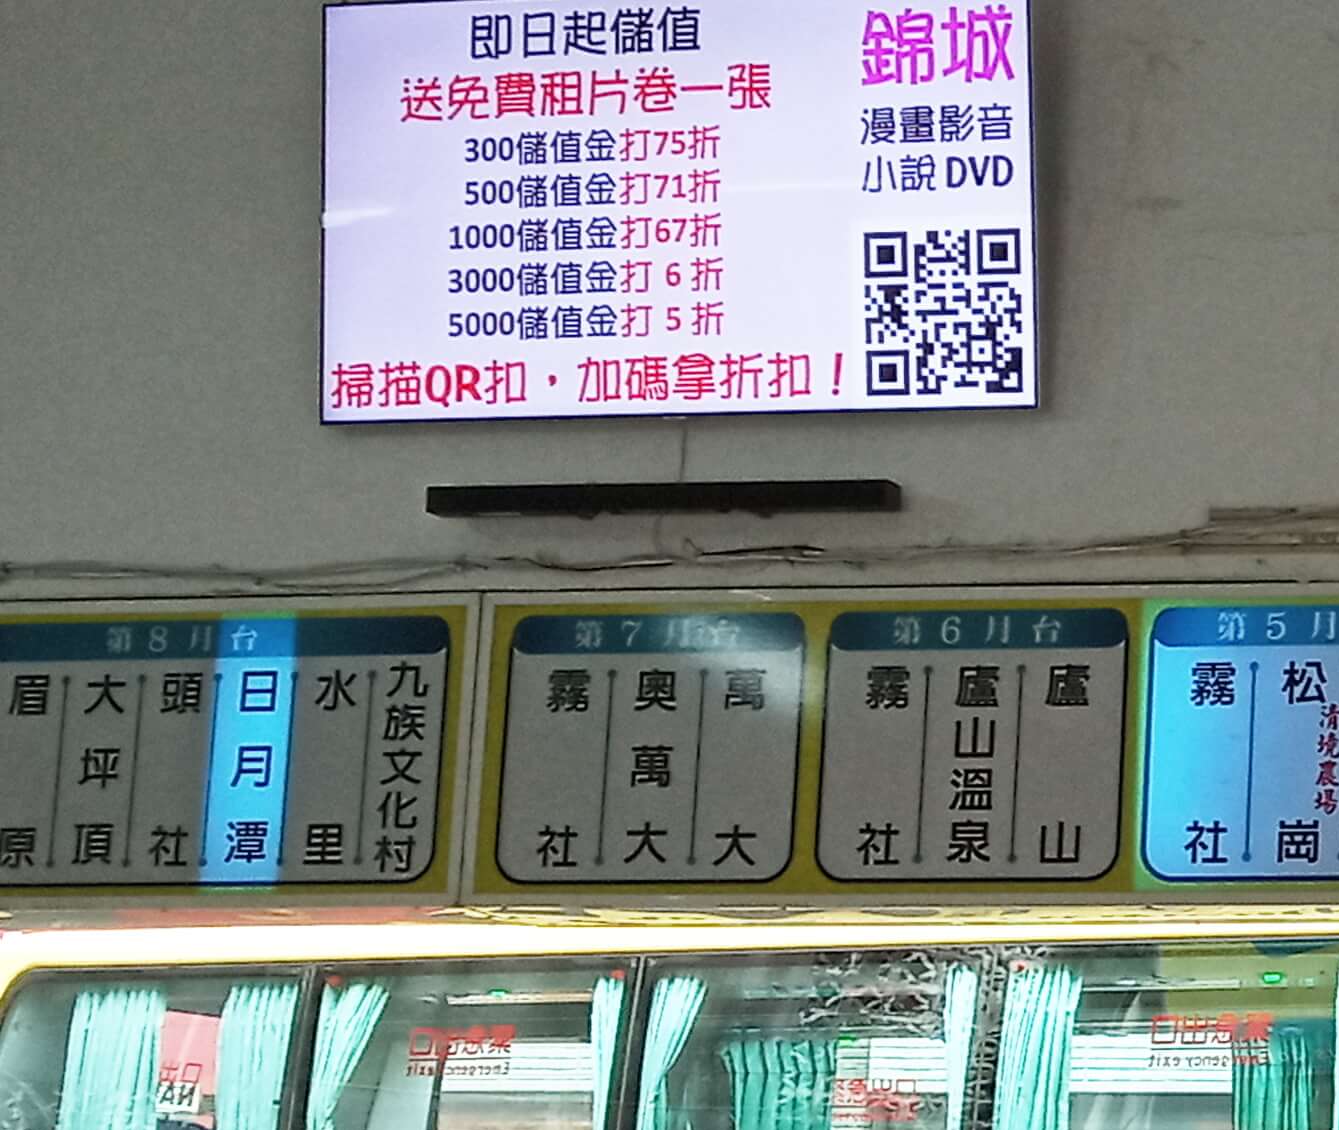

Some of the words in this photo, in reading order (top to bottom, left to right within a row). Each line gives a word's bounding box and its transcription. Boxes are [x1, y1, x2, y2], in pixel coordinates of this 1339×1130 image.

[469, 5, 703, 59] 即日起儲值
[861, 6, 1015, 86] 錦城
[400, 63, 773, 124] 送免費租片卷一張
[464, 126, 721, 165] 300儲值金打75折
[861, 104, 1014, 145] 漫畫影音
[464, 170, 721, 207] 500儲值金打71折
[861, 155, 937, 194] 小說
[946, 154, 1013, 189] DVD
[448, 214, 722, 252] 1000儲值金打67折
[223, 669, 277, 867] 日月潭
[373, 664, 430, 874] 九族文化村
